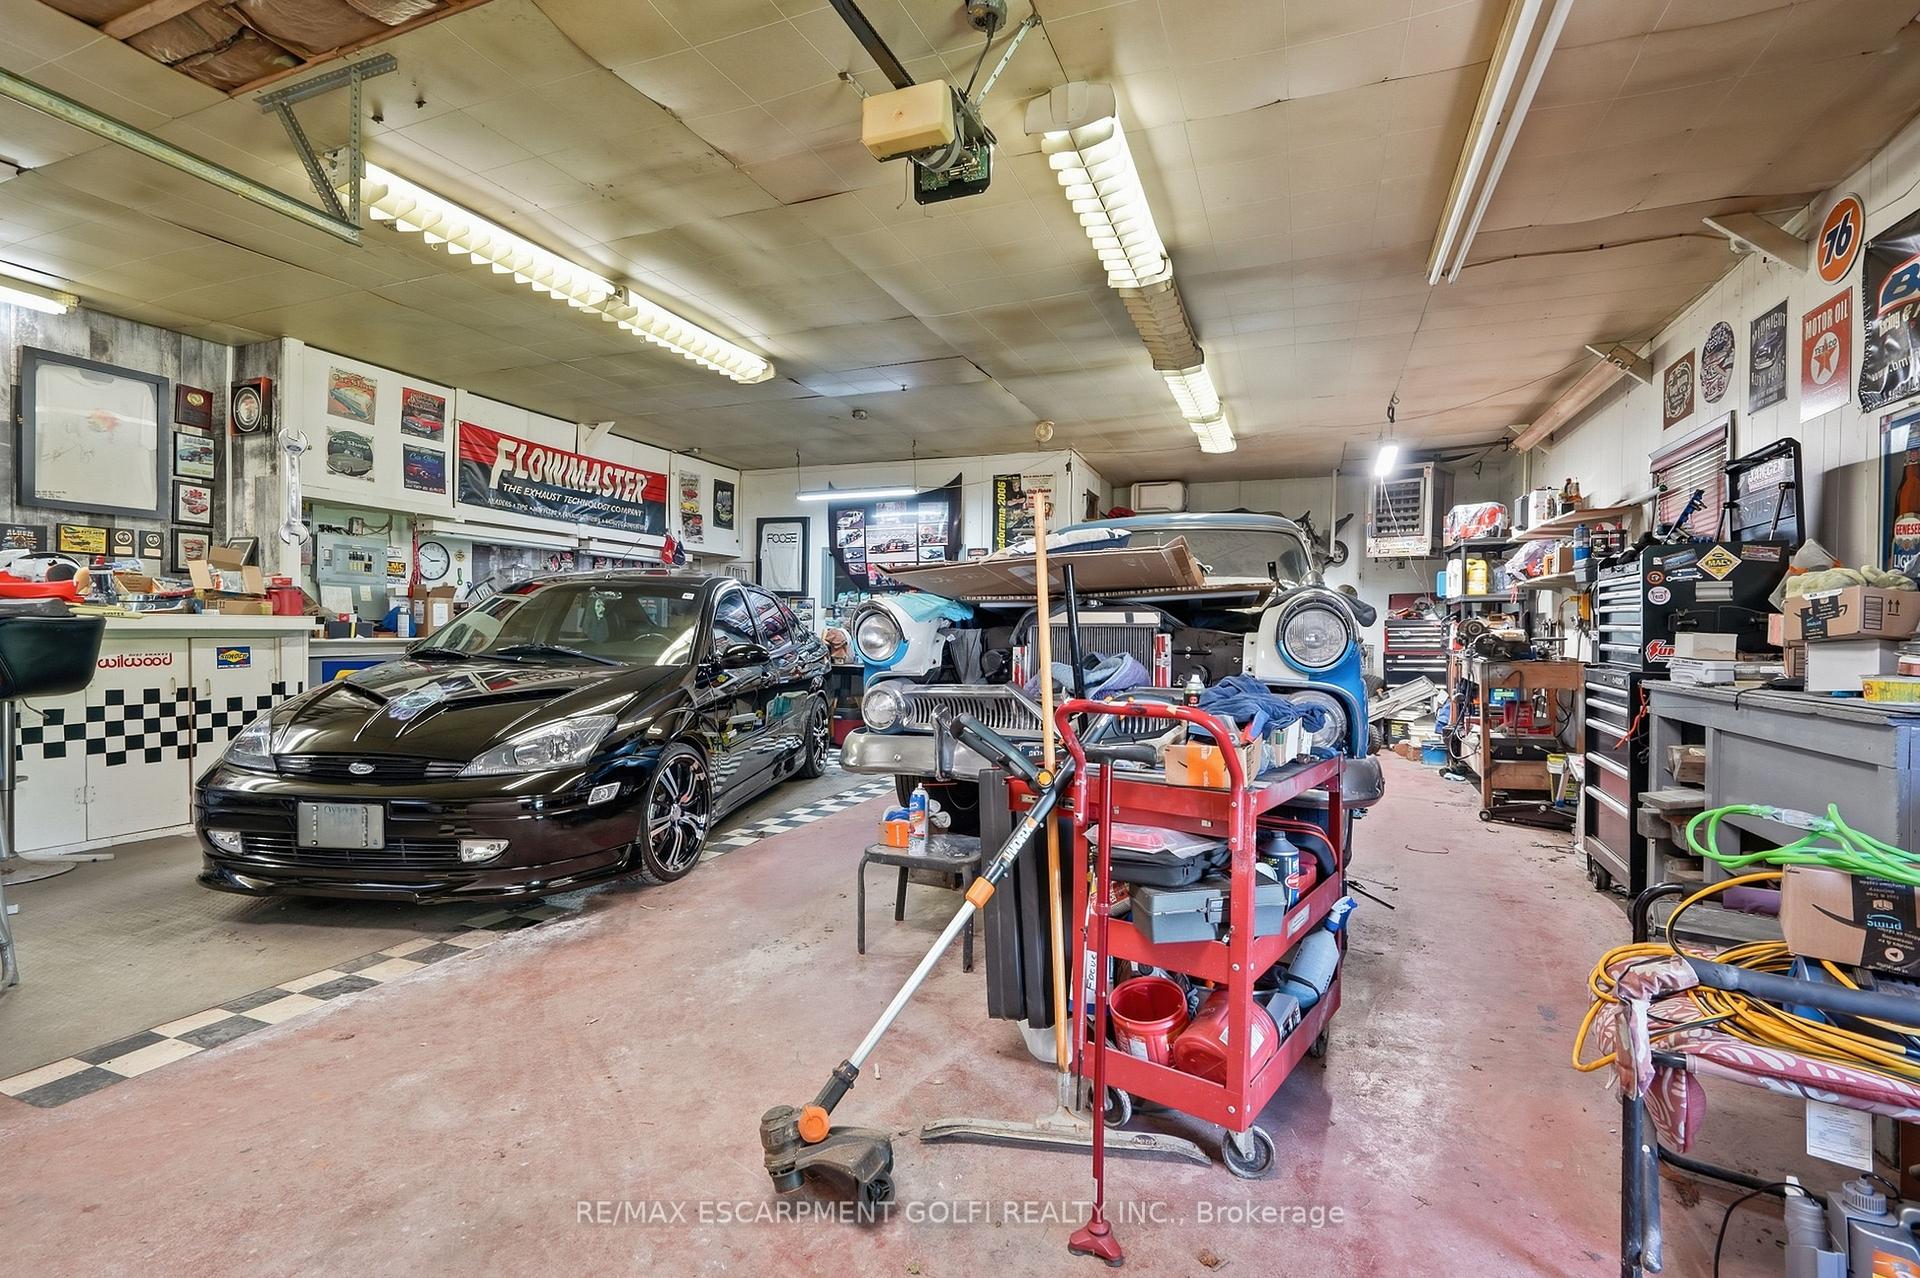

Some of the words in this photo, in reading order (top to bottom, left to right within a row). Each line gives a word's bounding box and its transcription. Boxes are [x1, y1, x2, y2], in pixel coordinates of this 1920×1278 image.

[1822, 209, 1854, 269] 76
[1805, 308, 1833, 340] MOTOR
[1834, 298, 1848, 324] OIL
[488, 438, 649, 505] FLOWMASTER
[503, 483, 522, 495] THE
[523, 487, 562, 502] EXHAUST
[563, 495, 611, 511] TECHNOLOGY
[611, 504, 644, 517] COMPANY
[997, 481, 1006, 507] 2006
[767, 532, 798, 543] FOOSE
[97, 652, 173, 669] wilwood
[1003, 825, 1035, 862] WORX
[1867, 920, 1902, 931] prime
